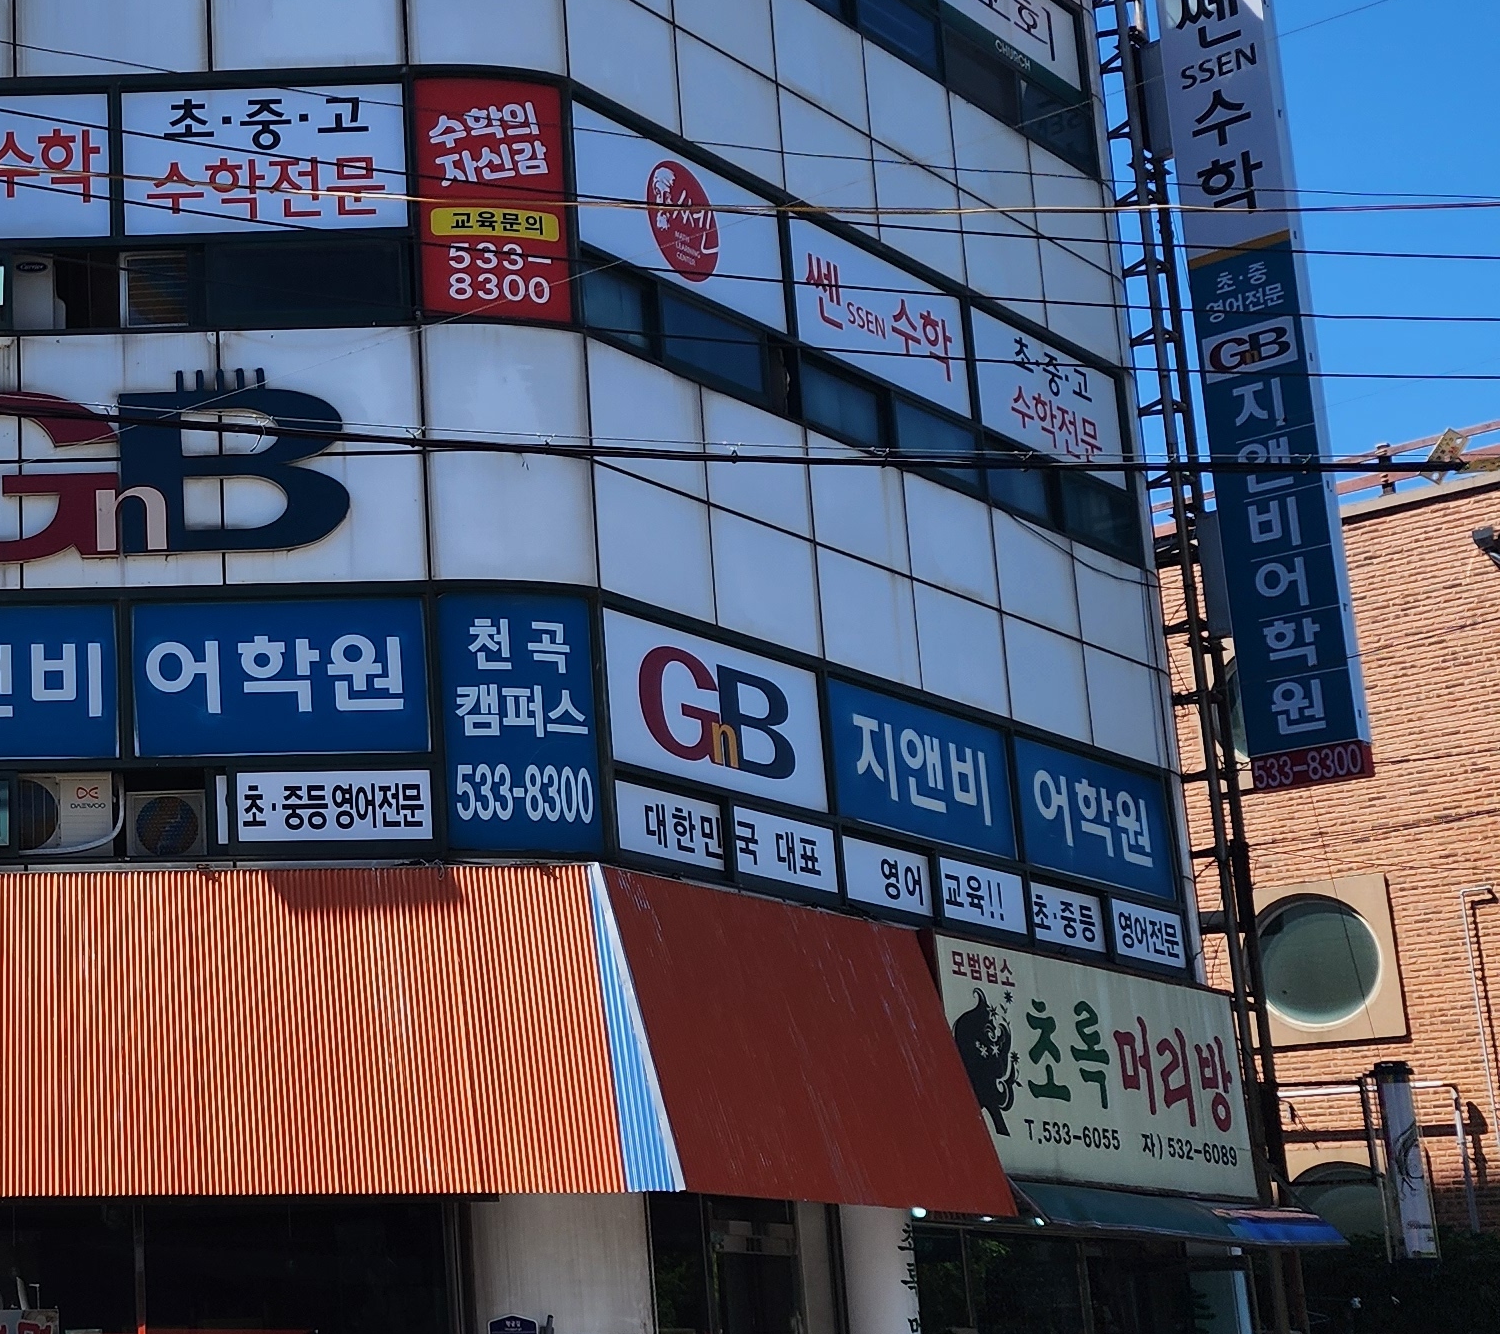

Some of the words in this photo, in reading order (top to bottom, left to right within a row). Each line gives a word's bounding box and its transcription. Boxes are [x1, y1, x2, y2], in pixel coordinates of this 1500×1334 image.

[995, 39, 1031, 72] CHURCH
[1181, 43, 1257, 90] SSEN
[430, 101, 539, 149] 수학의
[437, 142, 548, 187] 자신감
[1192, 89, 1264, 214] 수학
[147, 156, 385, 220] 수학전문
[452, 211, 545, 235] 교육문의
[450, 274, 550, 303] 8300
[1206, 283, 1284, 323] 영어전문
[805, 252, 844, 332] 쎈
[847, 300, 887, 341] SSEN
[891, 298, 953, 383] 수학
[1010, 384, 1103, 463] 수학전문
[146, 633, 406, 715] 어학원
[454, 684, 588, 739] 캠퍼스
[852, 712, 992, 826] 지앤비
[1033, 768, 1153, 867] 어학원
[1254, 744, 1361, 790] 533-8300
[331, 782, 425, 831] 영어전문
[454, 763, 596, 826] 533-8300
[644, 803, 759, 865] 대한민국
[776, 831, 821, 876] 대표
[881, 857, 924, 906] 영어
[944, 873, 1005, 921] 교육!!
[1118, 911, 1180, 959] 영어전문
[952, 950, 1015, 987] 모범업소
[1168, 1135, 1237, 1166] 532-6089
